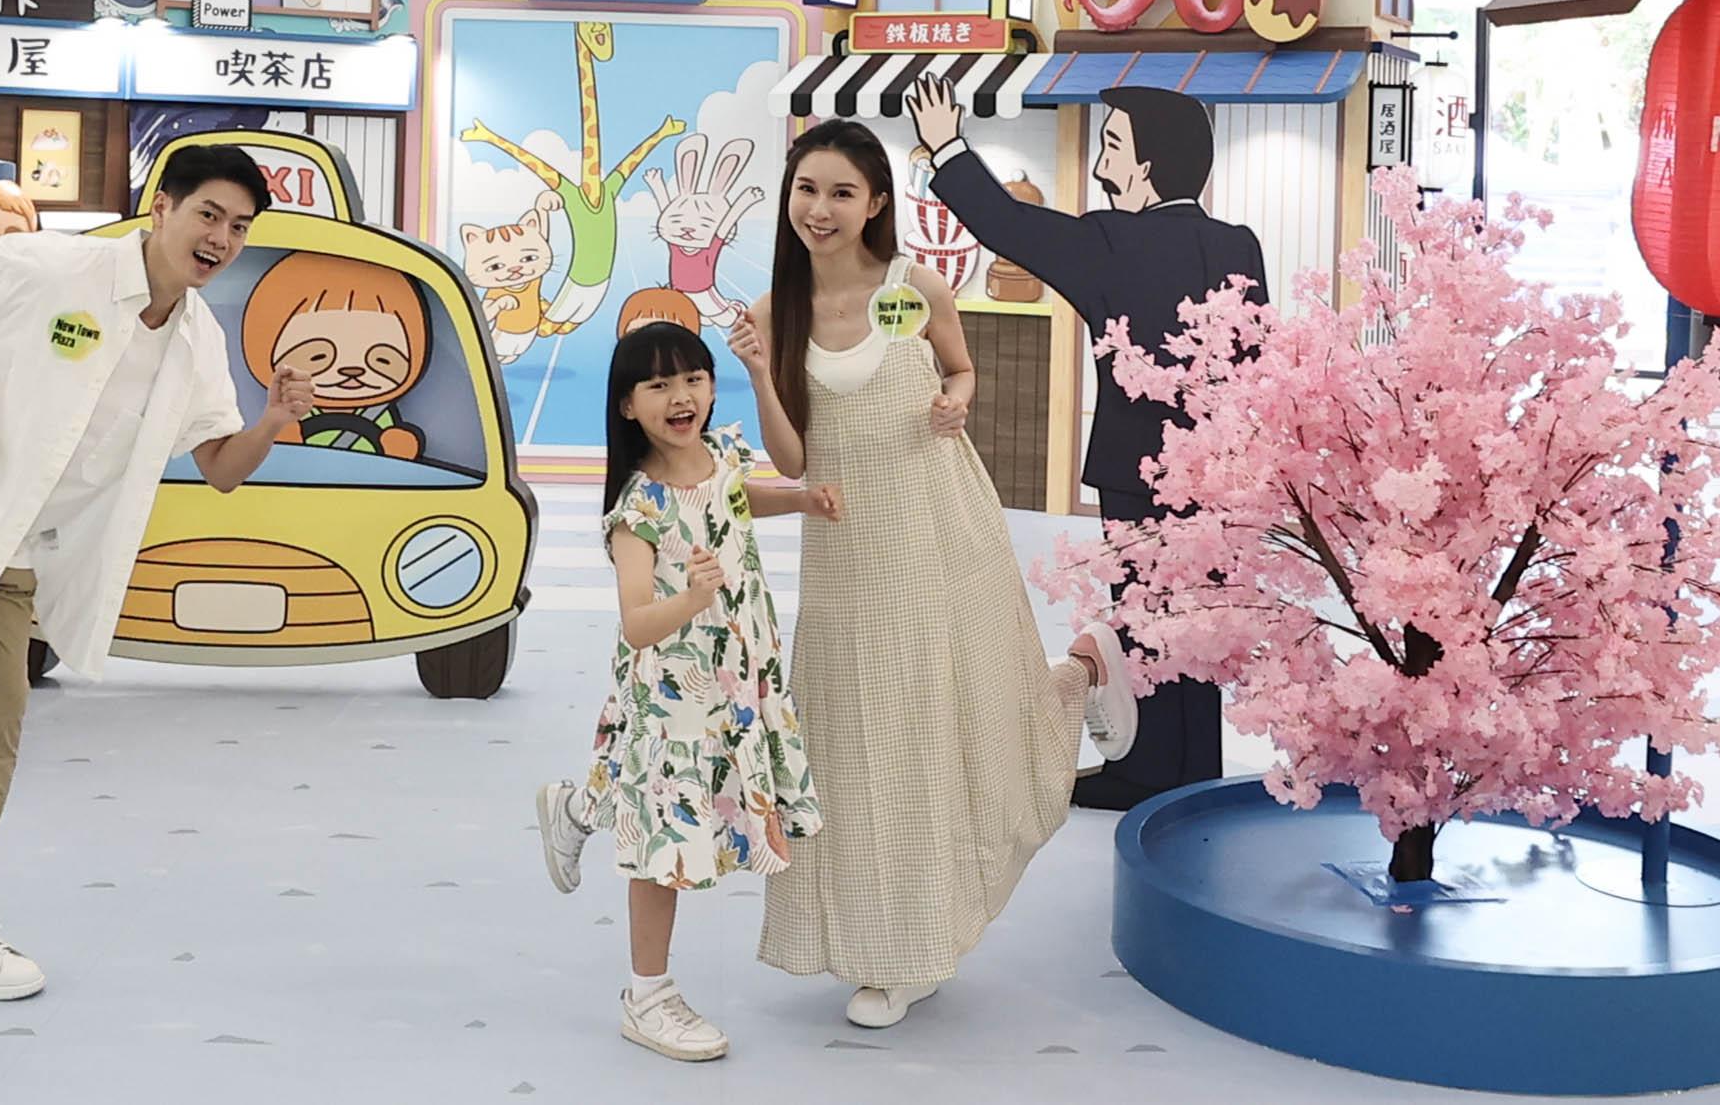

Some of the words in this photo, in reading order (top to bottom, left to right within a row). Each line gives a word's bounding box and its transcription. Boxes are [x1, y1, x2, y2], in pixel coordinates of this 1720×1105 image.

[203, 2, 246, 18] Power
[885, 22, 972, 44] 鉄板焼き
[216, 48, 336, 91] 喫茶店
[1379, 102, 1397, 155] 居酒屋
[51, 331, 76, 348] Plaza
[54, 318, 76, 334] New
[76, 322, 100, 341] Town
